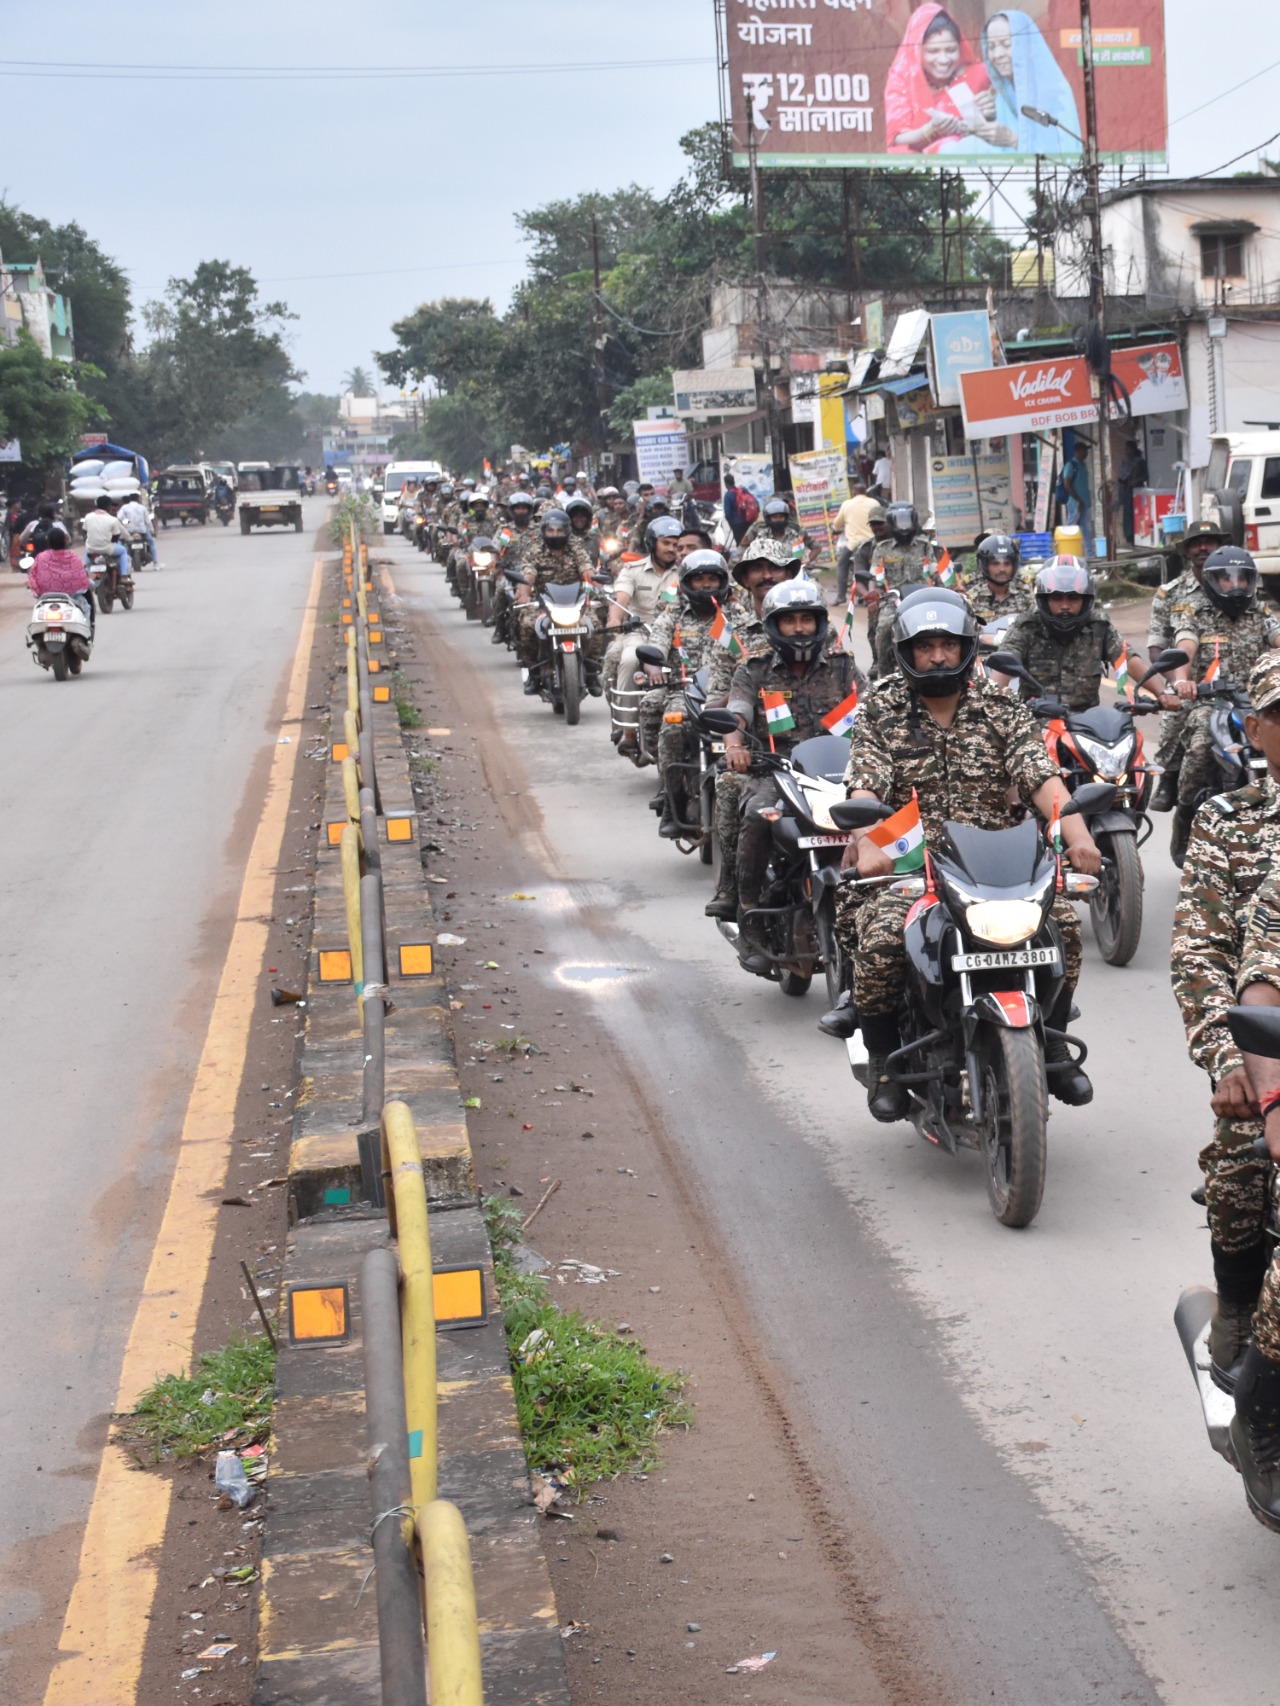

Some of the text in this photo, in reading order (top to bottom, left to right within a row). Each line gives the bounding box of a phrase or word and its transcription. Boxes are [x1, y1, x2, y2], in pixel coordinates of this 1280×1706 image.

[737, 15, 813, 45] योजना
[777, 107, 874, 132] सालाना
[1009, 367, 1073, 400] Vadilal
[1024, 396, 1062, 408] ICE CREAM
[1031, 415, 1052, 428] BDF
[1055, 411, 1077, 424] BOB
